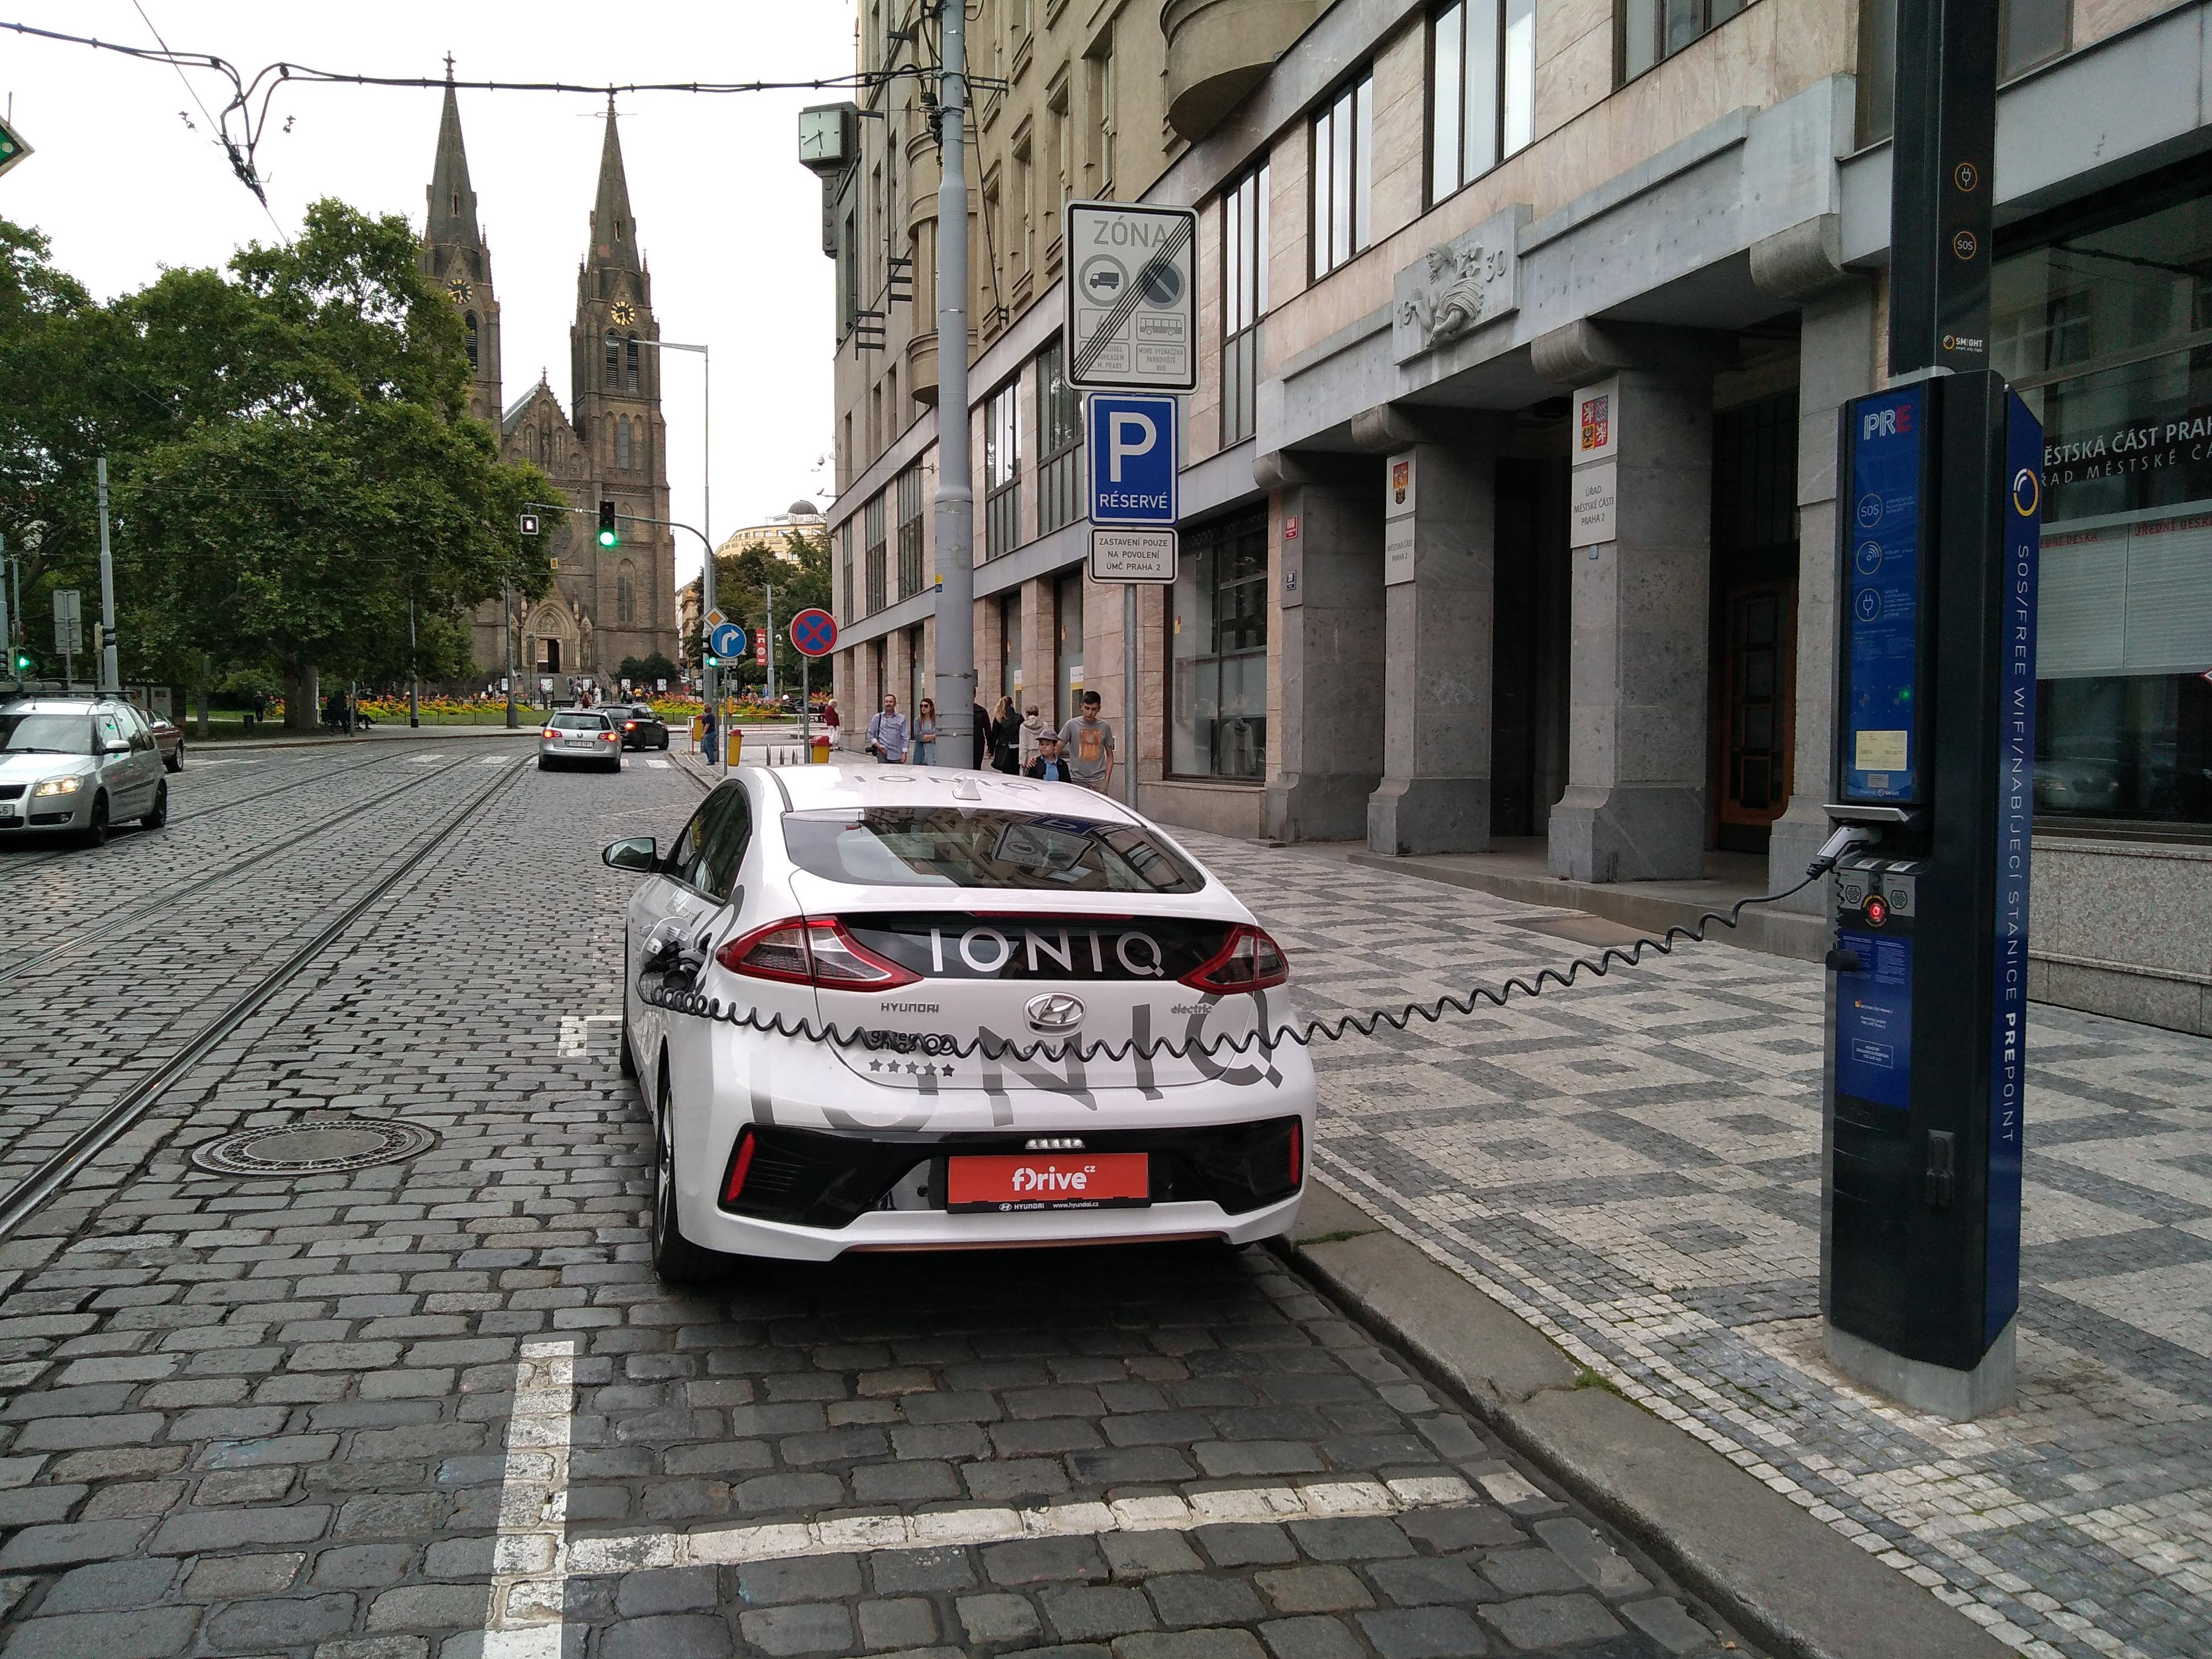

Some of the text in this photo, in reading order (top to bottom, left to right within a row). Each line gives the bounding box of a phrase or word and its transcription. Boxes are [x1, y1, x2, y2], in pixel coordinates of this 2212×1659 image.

[1093, 215, 1168, 248] ZÓNA
[1957, 239, 1974, 251] SOS
[1864, 404, 1911, 441] PRE
[1109, 411, 1157, 483] P
[2044, 435, 2106, 466] ĚSTSKÁ
[2112, 427, 2158, 453] ČÁST
[2086, 448, 2176, 479] MĚSTSKÉ
[1099, 490, 1168, 509] RÉSERVÉ
[1585, 485, 1601, 497] ÚŘAD
[1573, 497, 1614, 514] MĚSTSKÉ ČÁSTI
[1861, 504, 1879, 517] SOS
[1582, 513, 1605, 525] PRAHA 2
[1099, 538, 1140, 546] ZASTAVENÍ
[1106, 561, 1123, 570] ÚMČ
[2014, 545, 2029, 675] SOS/FREE
[930, 927, 1164, 976] IONIQ
[2005, 891, 2019, 1000] STANICE
[881, 1002, 940, 1013] HYUNDAI
[1171, 1003, 1212, 1014] electric
[870, 1030, 918, 1043] geen
[880, 1042, 917, 1055] nap
[2001, 1012, 2017, 1142] PREPOINT
[1011, 1165, 1087, 1191] fDrive
